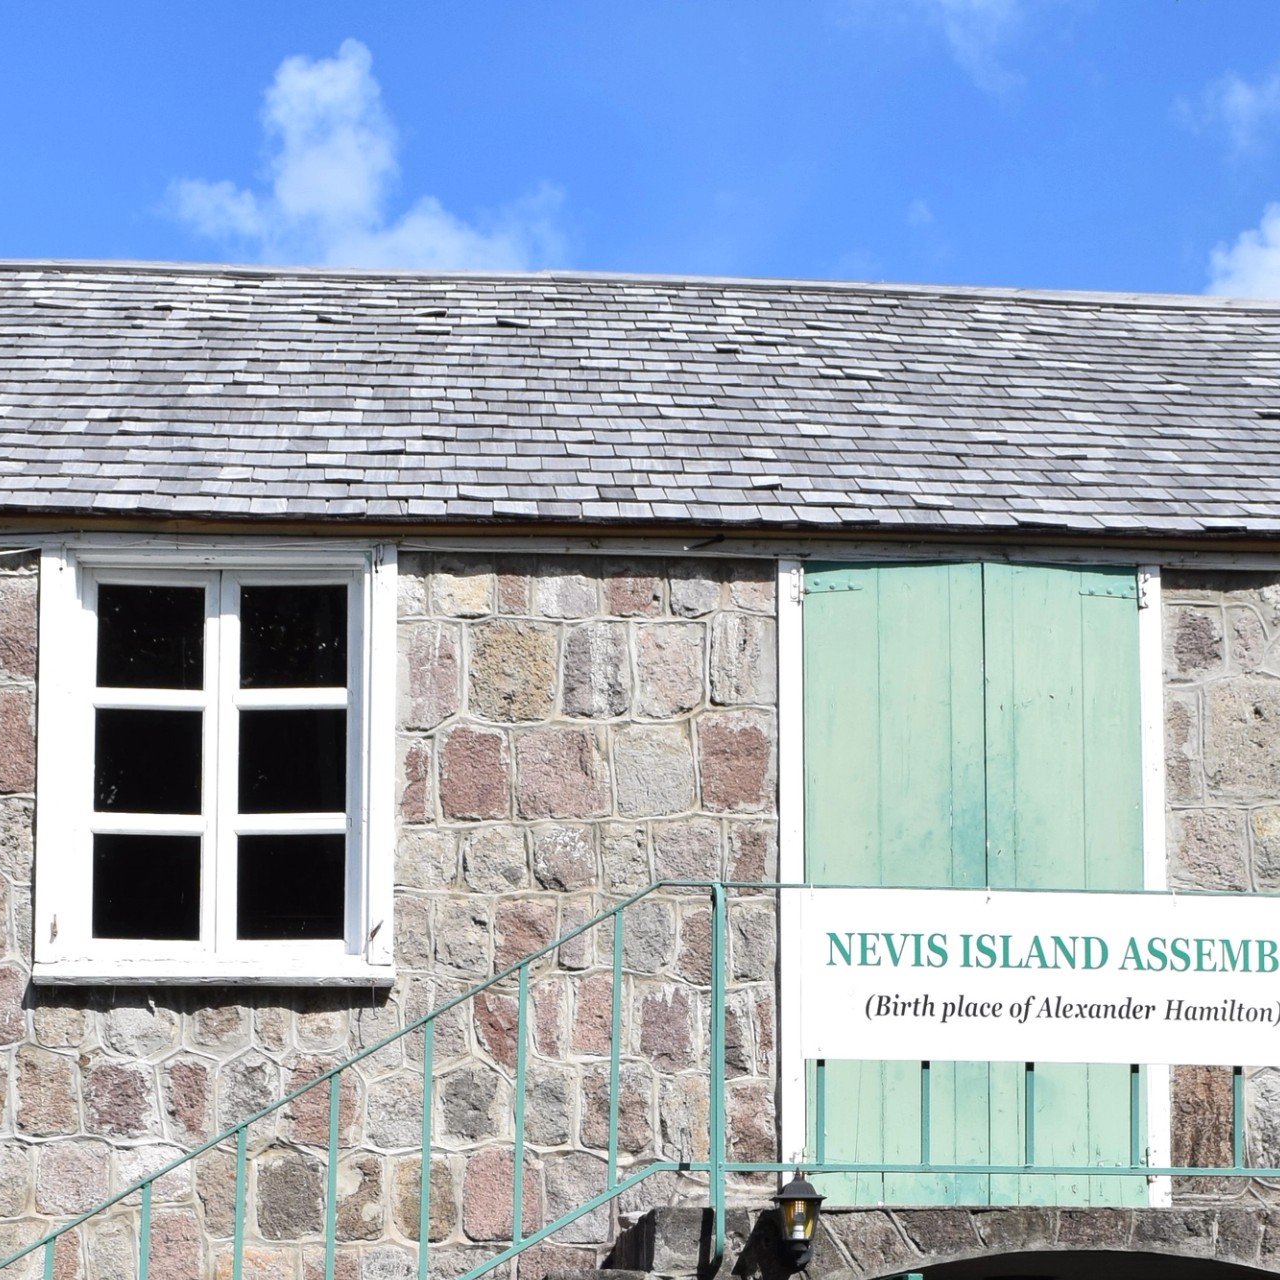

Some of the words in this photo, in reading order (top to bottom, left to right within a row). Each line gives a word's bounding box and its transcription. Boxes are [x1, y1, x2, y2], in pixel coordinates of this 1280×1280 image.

[825, 932, 949, 968] NEVIS
[959, 933, 1109, 970] ISLAND
[865, 993, 936, 1021] (Birth
[941, 995, 1003, 1024] place
[1009, 995, 1036, 1024] of
[1036, 995, 1156, 1020] Alexander
